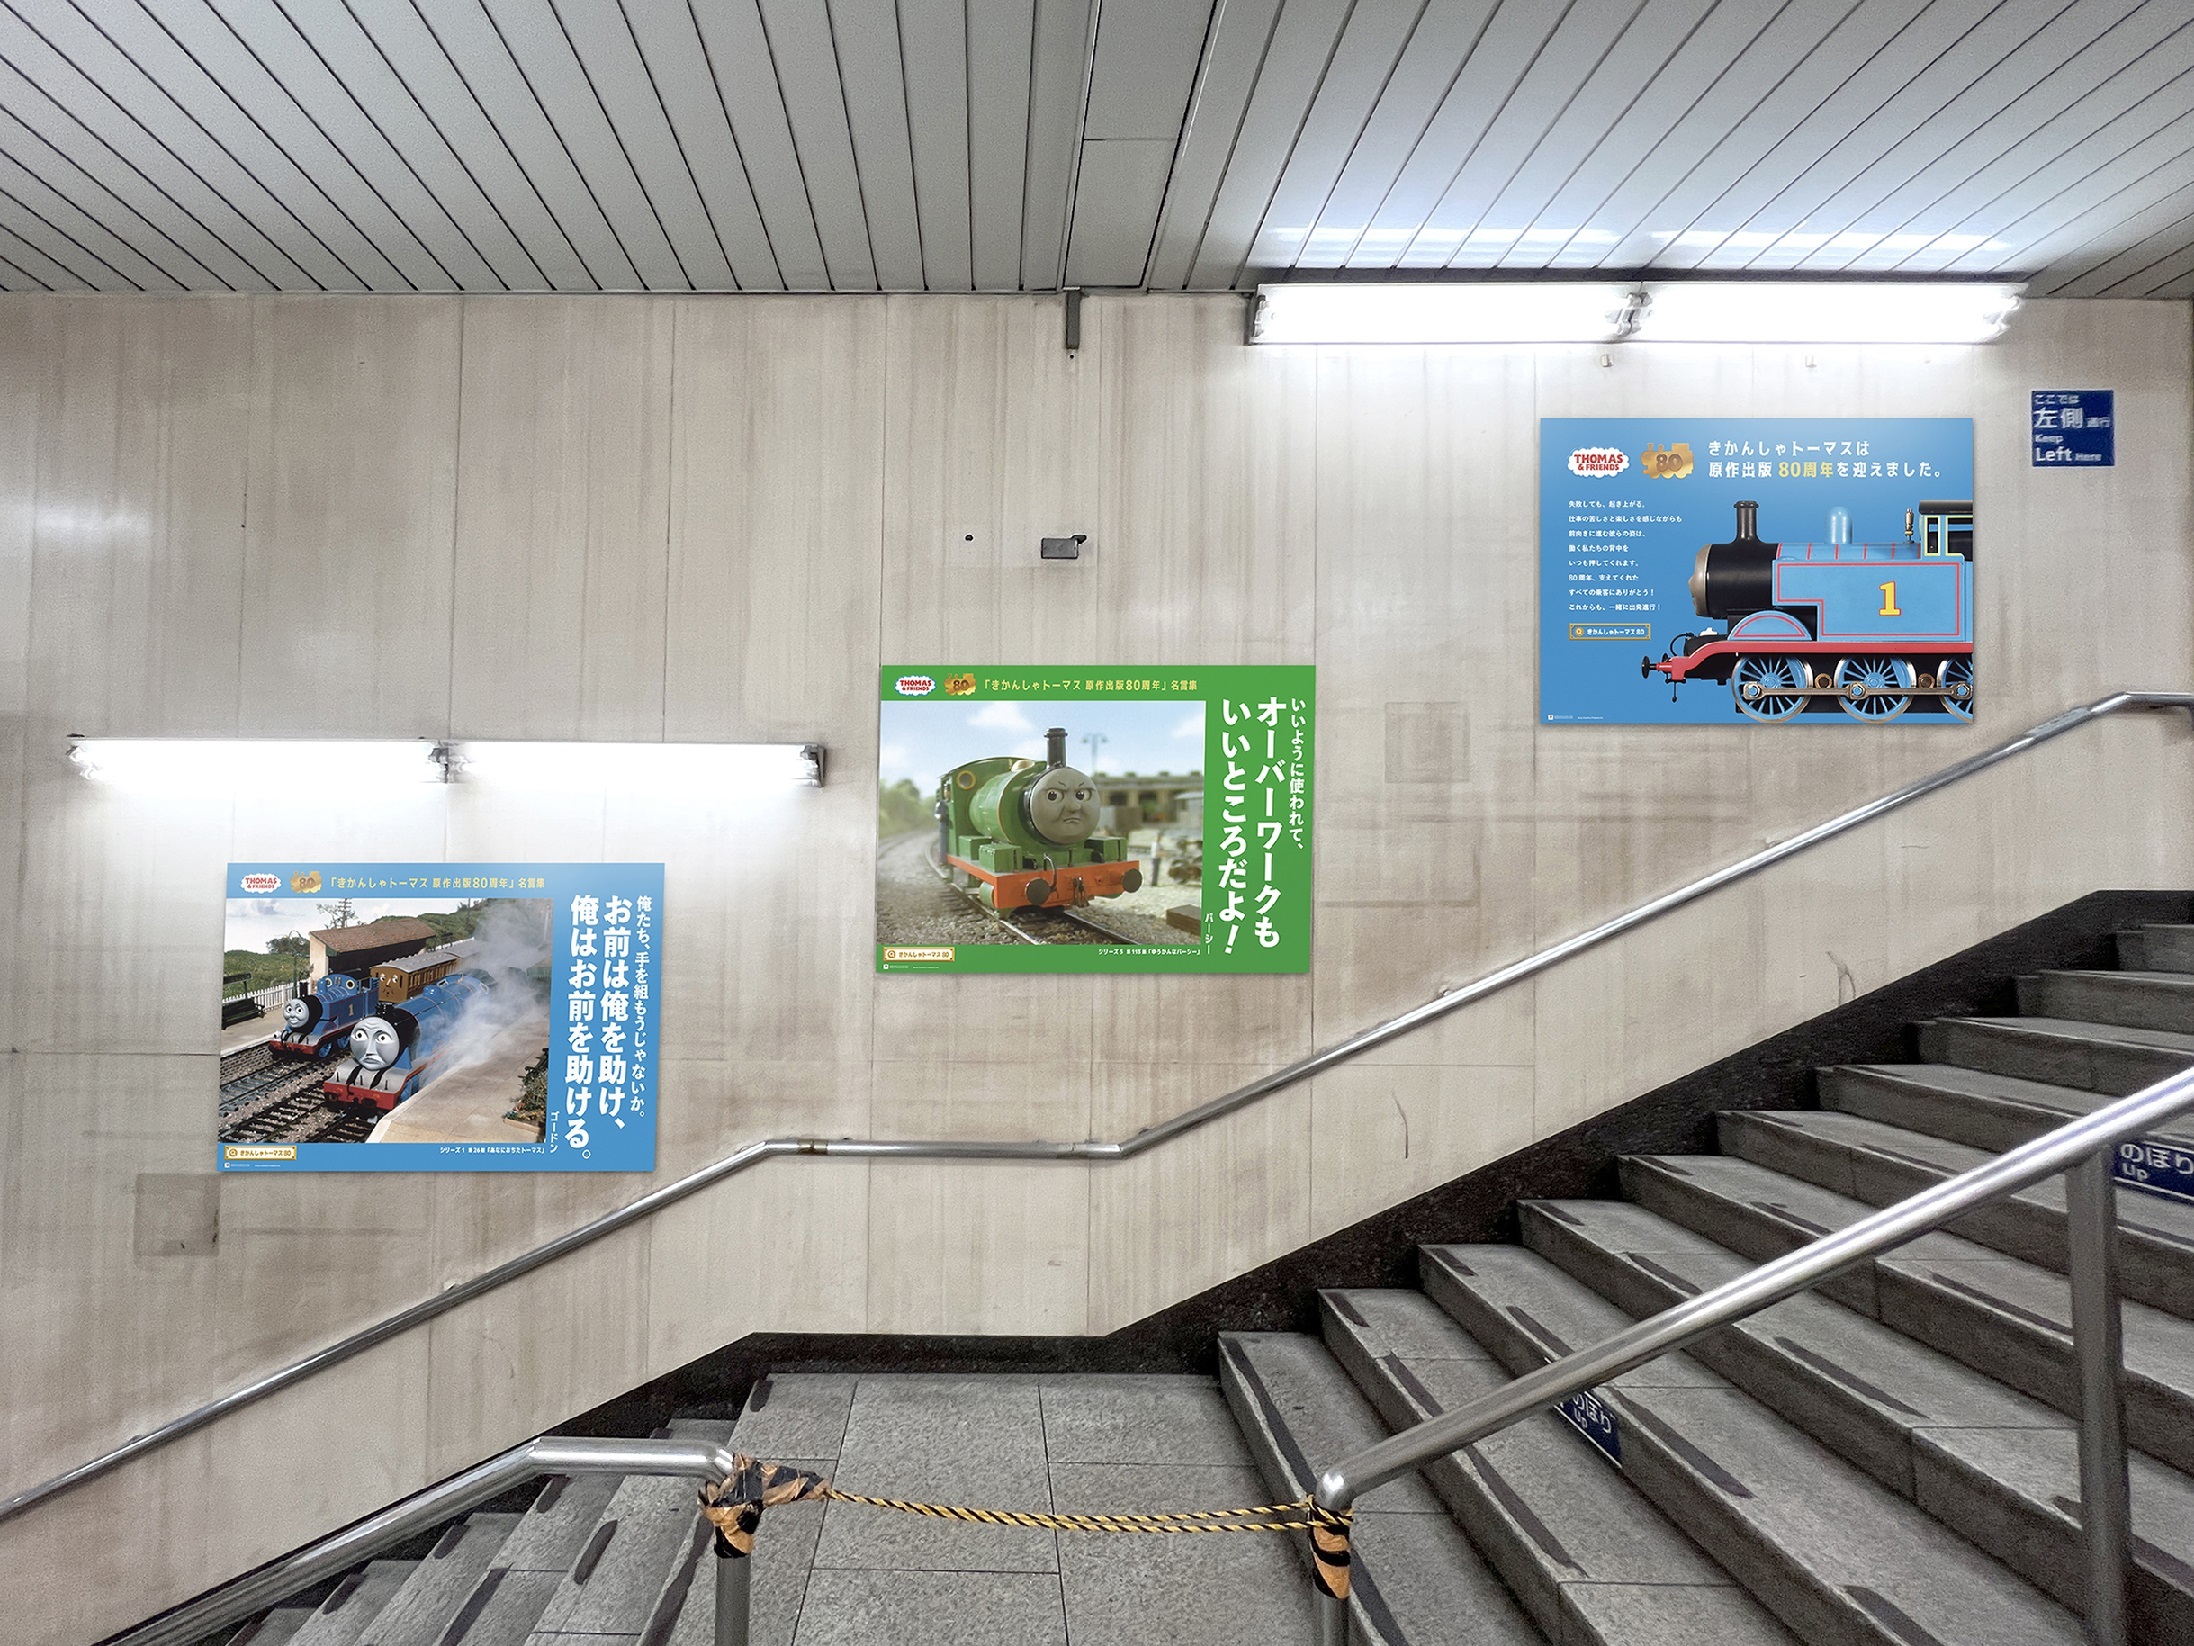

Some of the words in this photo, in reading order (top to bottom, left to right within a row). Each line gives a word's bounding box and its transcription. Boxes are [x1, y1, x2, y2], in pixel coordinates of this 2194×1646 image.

[1708, 440, 1870, 456] きかんしゃトーマスは
[2035, 434, 2064, 444] Keep
[1574, 453, 1624, 465] THOMAS
[1655, 453, 1682, 472] 80
[2036, 446, 2073, 462] Left
[1878, 581, 1902, 616] 1
[900, 679, 932, 687] THOMAS
[953, 679, 970, 691] 80
[984, 678, 1081, 691] 「きかんしゃトーマス
[1289, 698, 1307, 850] いいように使われて、
[1218, 698, 1251, 954] いいところだよ！
[1254, 696, 1287, 948] オーバーワークも
[299, 877, 316, 889] 80
[330, 876, 428, 889] 「きかんしゃトーマス
[1205, 913, 1214, 954] パーシー
[348, 1003, 354, 1016] 1
[598, 895, 632, 1129] お前は俺を助け、
[630, 895, 653, 1117] 俺たち、手を組もうじゃないか。
[564, 894, 599, 1159] 俺はお前を助ける。
[550, 1110, 560, 1153] ゴードン
[2120, 1143, 2194, 1175] のぼり
